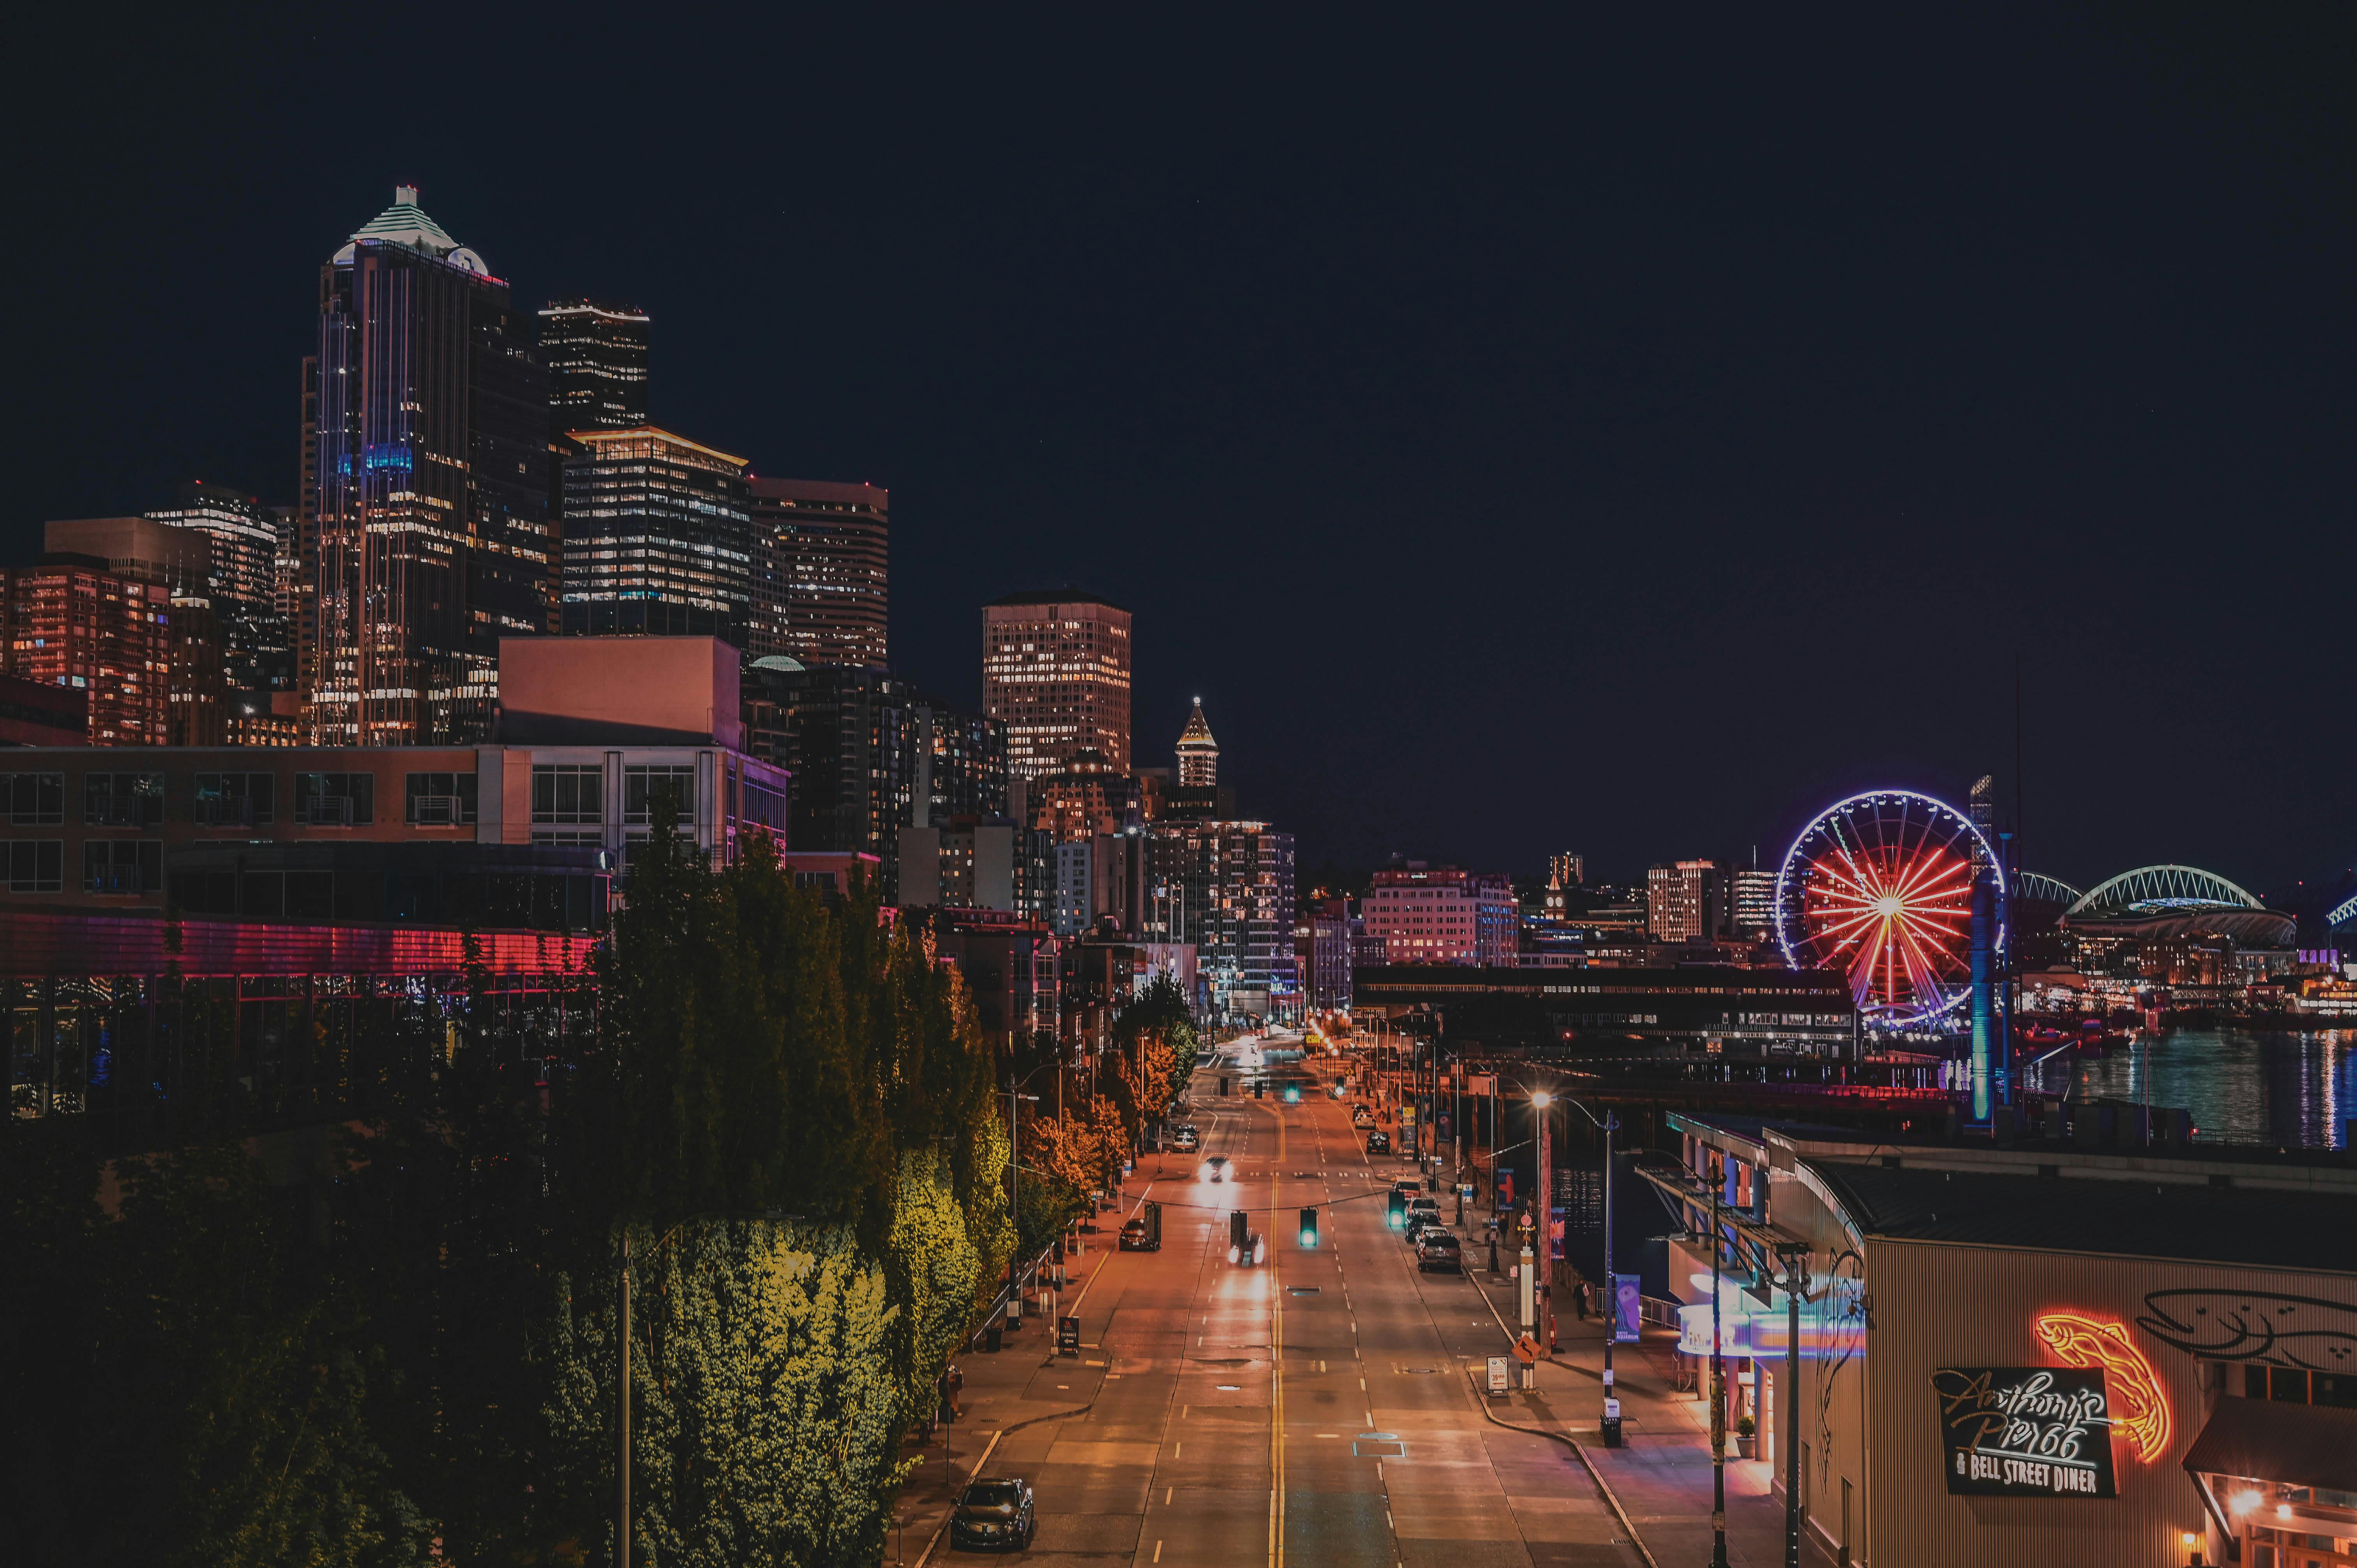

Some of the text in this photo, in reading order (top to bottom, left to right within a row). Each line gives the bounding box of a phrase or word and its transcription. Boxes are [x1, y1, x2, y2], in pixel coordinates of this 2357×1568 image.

[1929, 1370, 2113, 1432] Anthony's
[1951, 1411, 2088, 1460] Pier 66
[1957, 1453, 2096, 1493] & BELL STREET DINER
